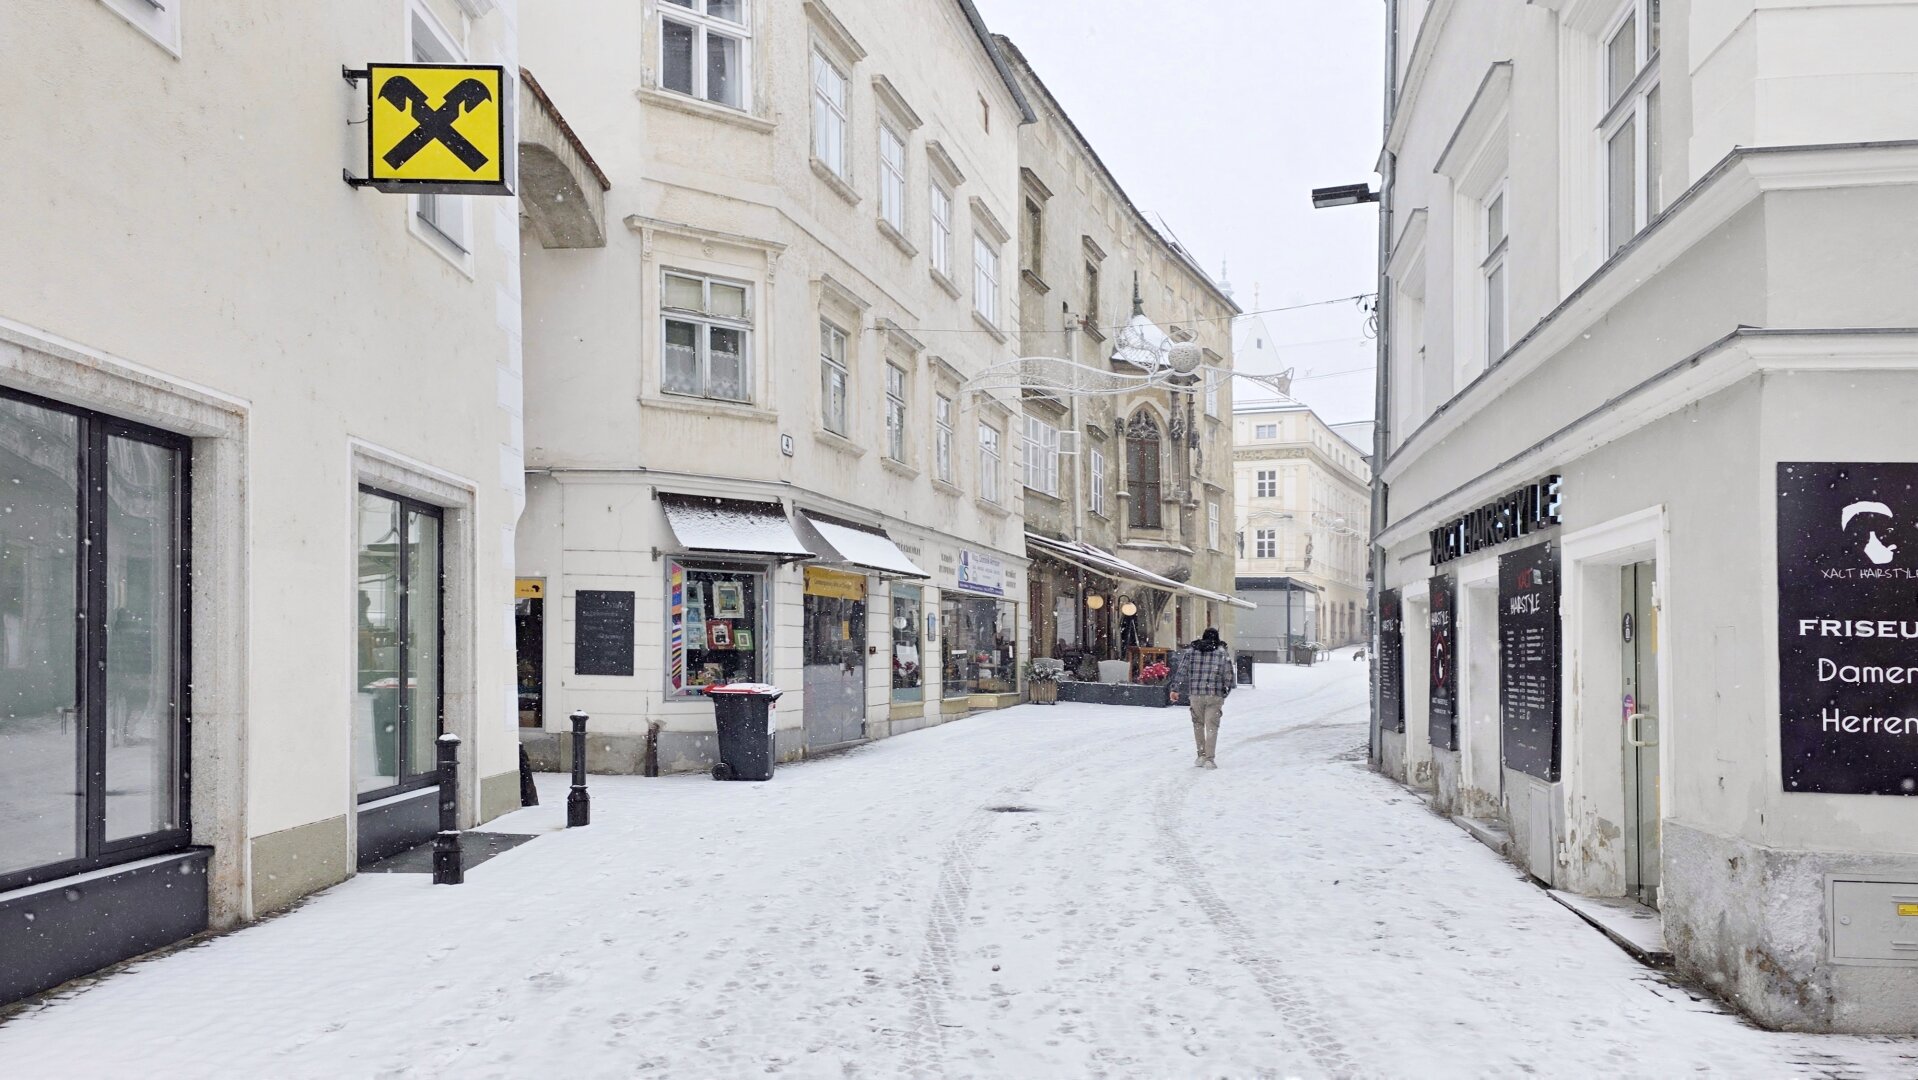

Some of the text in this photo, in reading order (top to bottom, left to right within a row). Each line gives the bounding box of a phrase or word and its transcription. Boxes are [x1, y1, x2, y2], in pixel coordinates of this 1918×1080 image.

[1463, 474, 1562, 553] HAIRSTYLE
[1821, 567, 1856, 579] XACT
[1822, 707, 1918, 734] Herren
